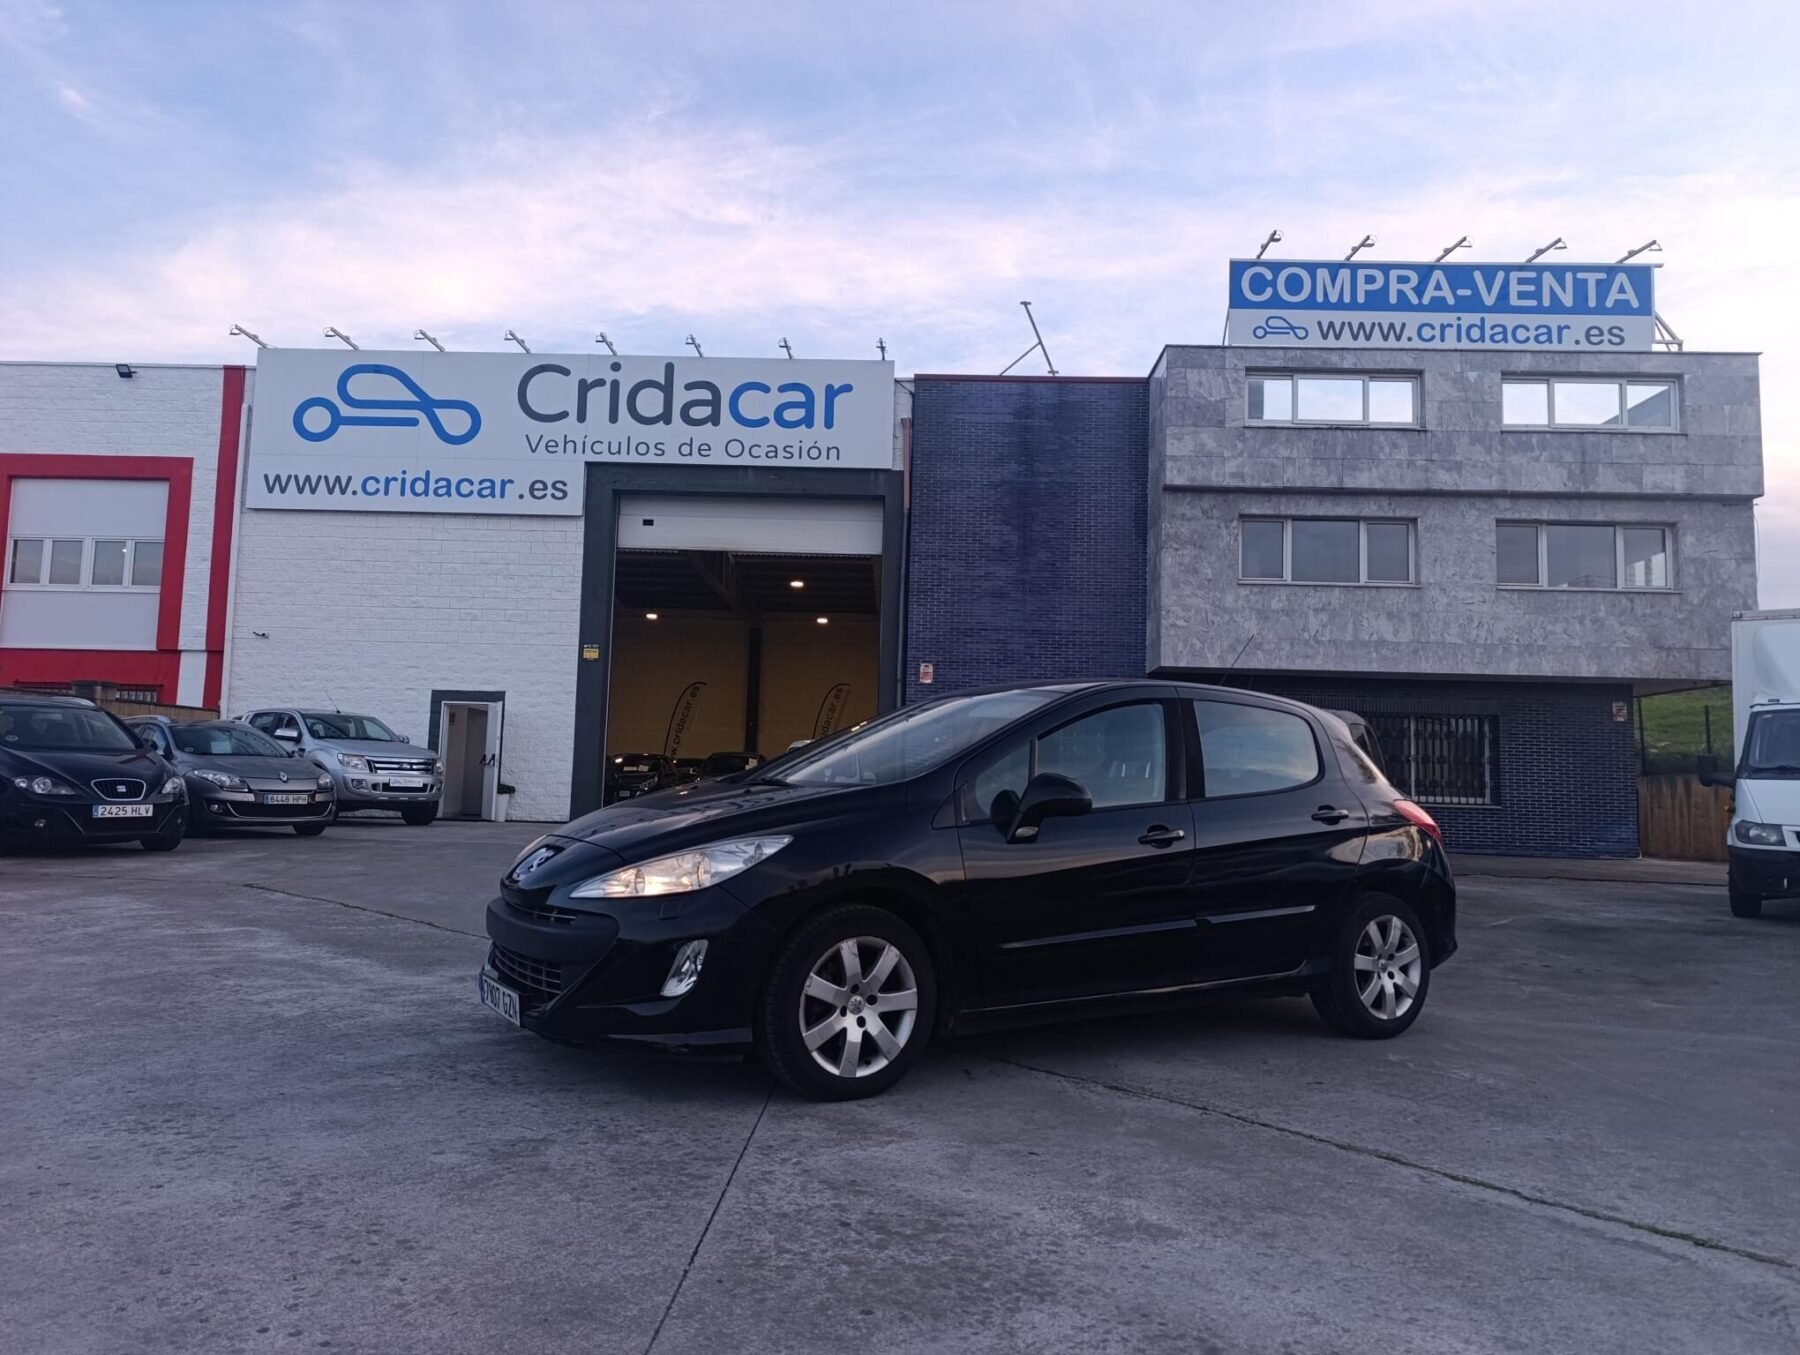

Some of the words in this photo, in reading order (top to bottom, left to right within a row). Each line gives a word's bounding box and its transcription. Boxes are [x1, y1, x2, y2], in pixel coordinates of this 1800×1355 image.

[1241, 266, 1640, 309] COMPRA-VENTA
[1316, 316, 1626, 346] www.cridacar.es
[517, 361, 854, 430] Cridacar
[525, 433, 666, 457] Vehículos
[677, 436, 712, 458] de
[724, 438, 840, 462] Ocasión
[263, 469, 569, 501] www.cridacar.es
[99, 806, 128, 816] 2425
[131, 806, 151, 816] HLV
